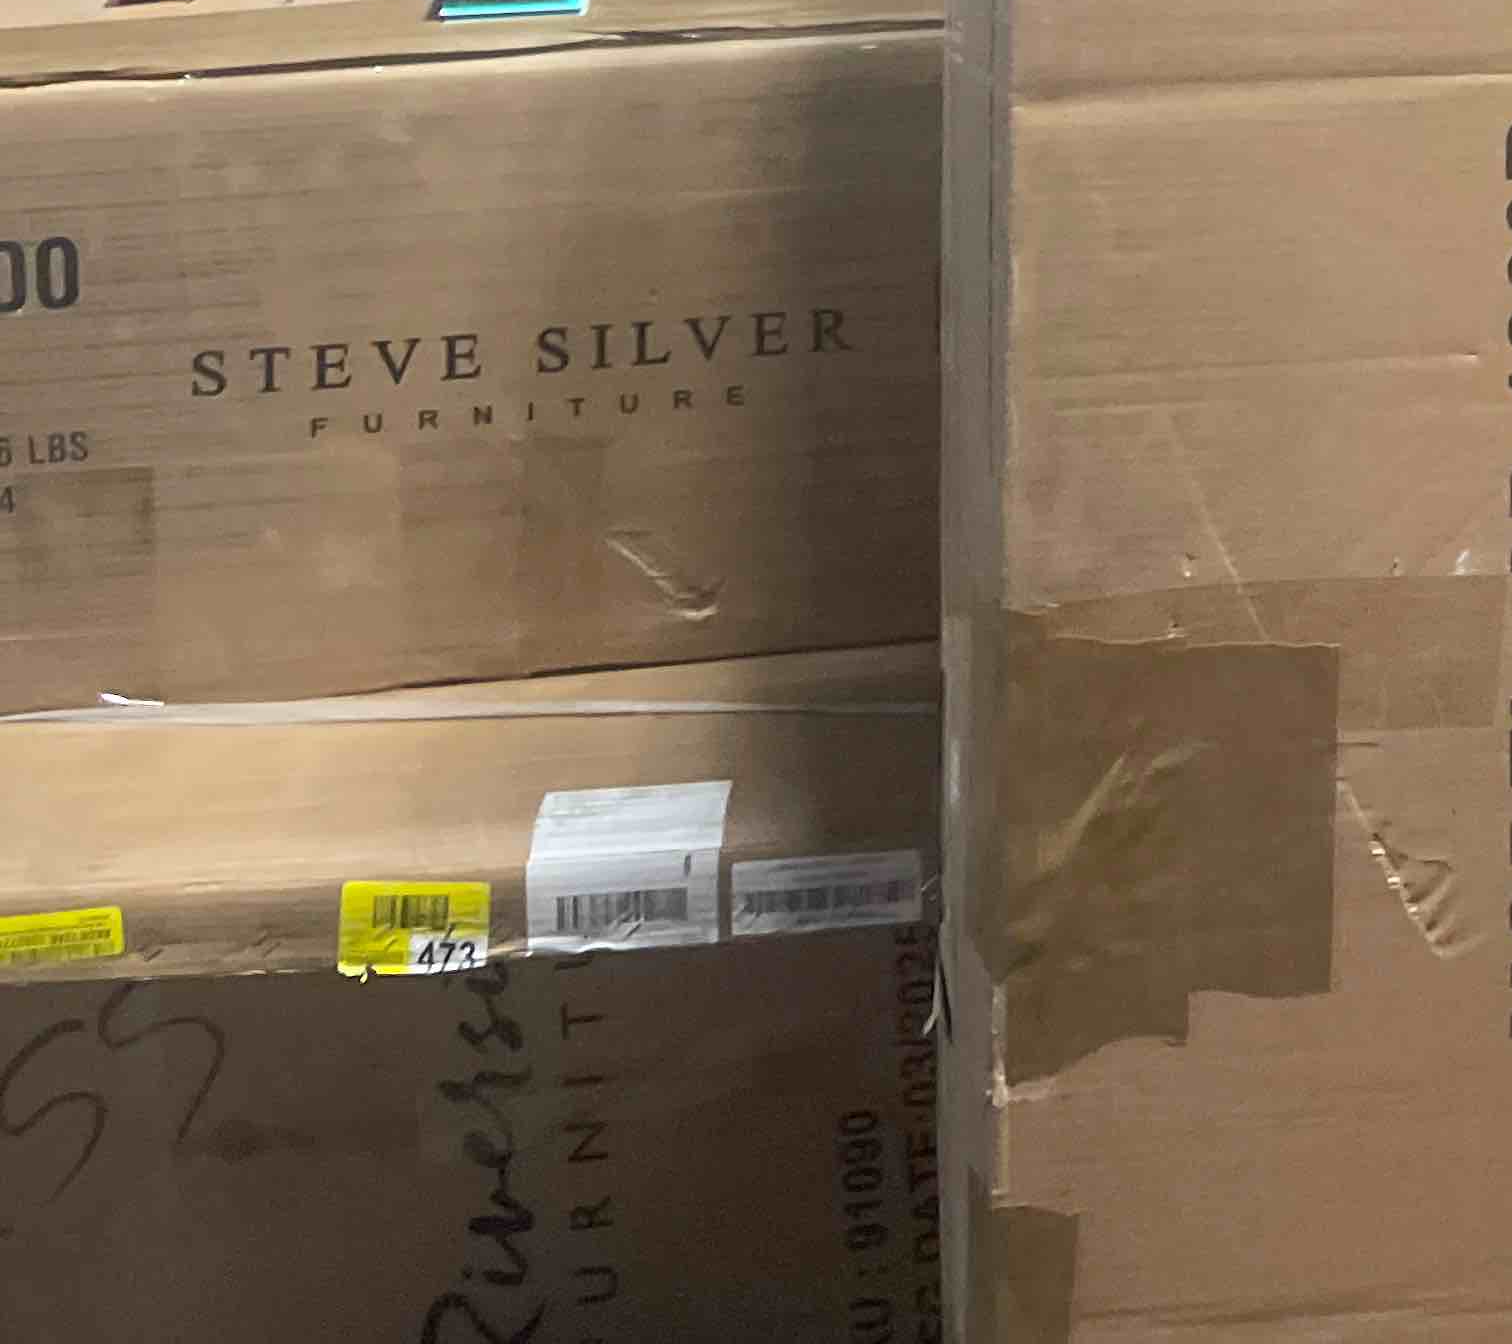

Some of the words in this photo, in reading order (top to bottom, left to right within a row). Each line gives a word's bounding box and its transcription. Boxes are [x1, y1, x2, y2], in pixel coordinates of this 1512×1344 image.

[191, 332, 483, 398] STEVE
[536, 308, 854, 375] SILVER
[28, 430, 88, 466] LBS
[310, 383, 748, 440] FURNITURE
[553, 955, 620, 1344] URNIT
